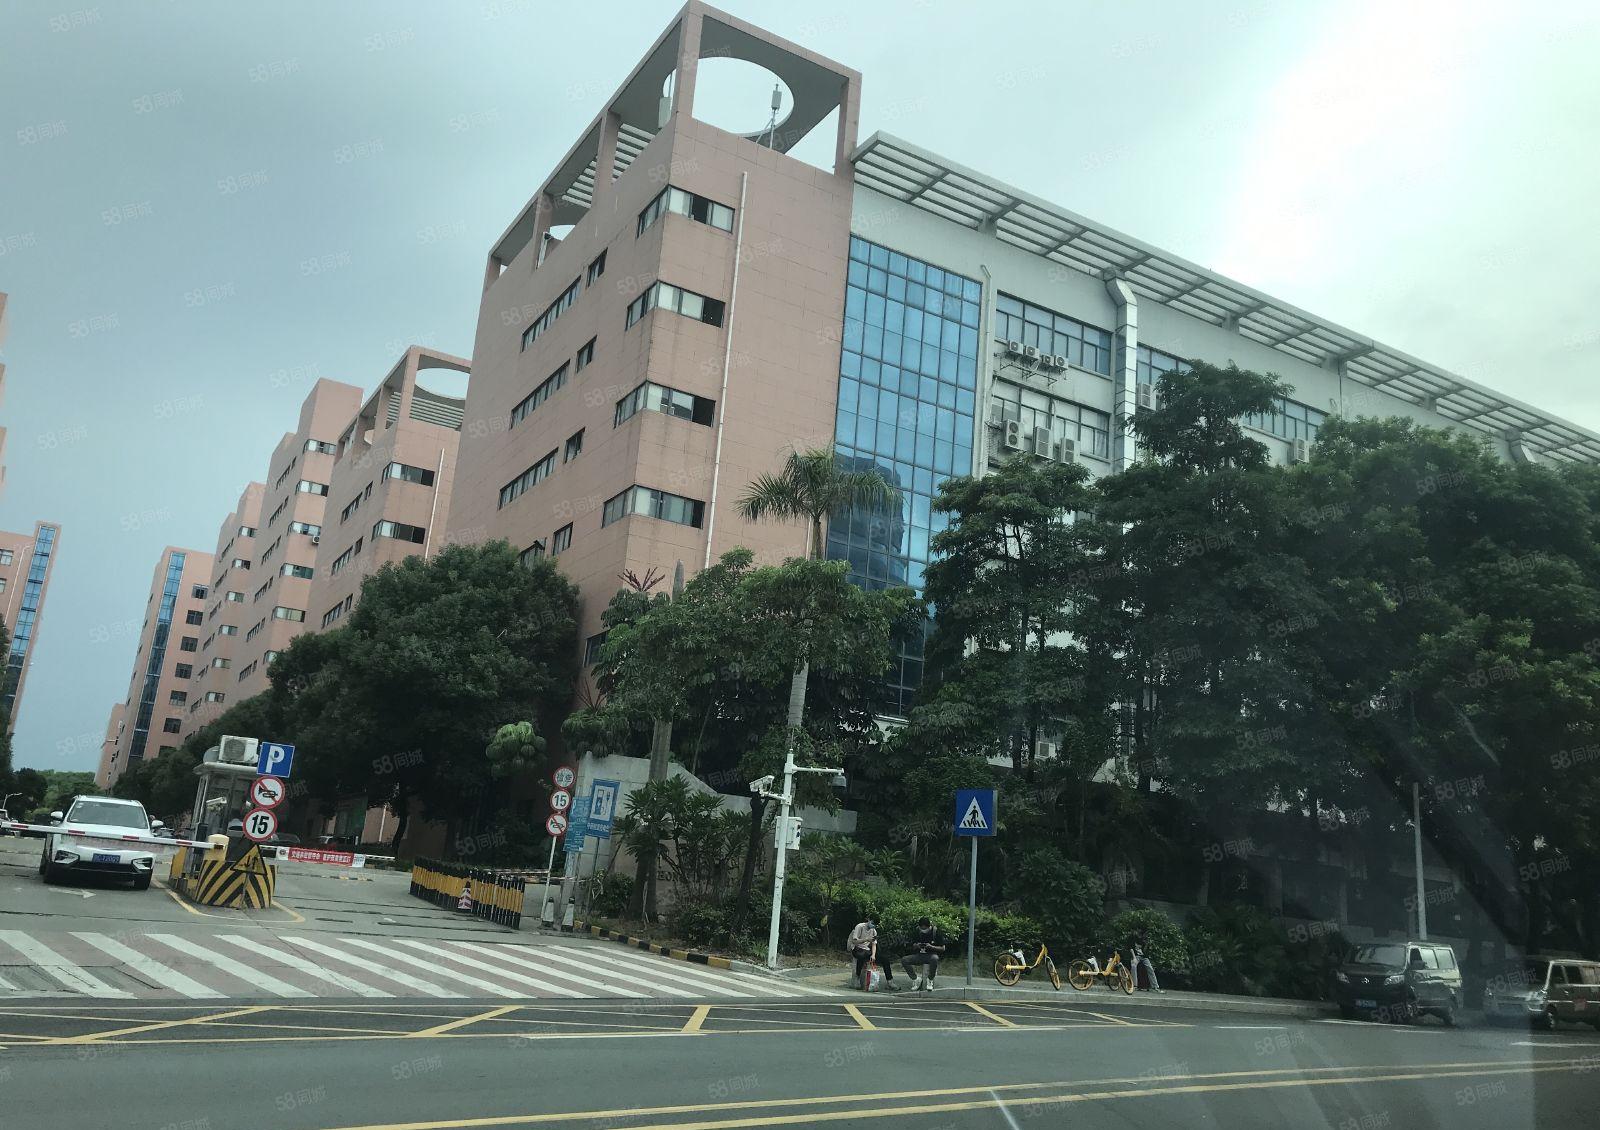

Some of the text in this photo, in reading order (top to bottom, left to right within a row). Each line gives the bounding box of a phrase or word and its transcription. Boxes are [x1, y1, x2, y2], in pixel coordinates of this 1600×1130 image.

[265, 745, 285, 773] P
[554, 794, 567, 807] 15
[251, 814, 270, 835] 15
